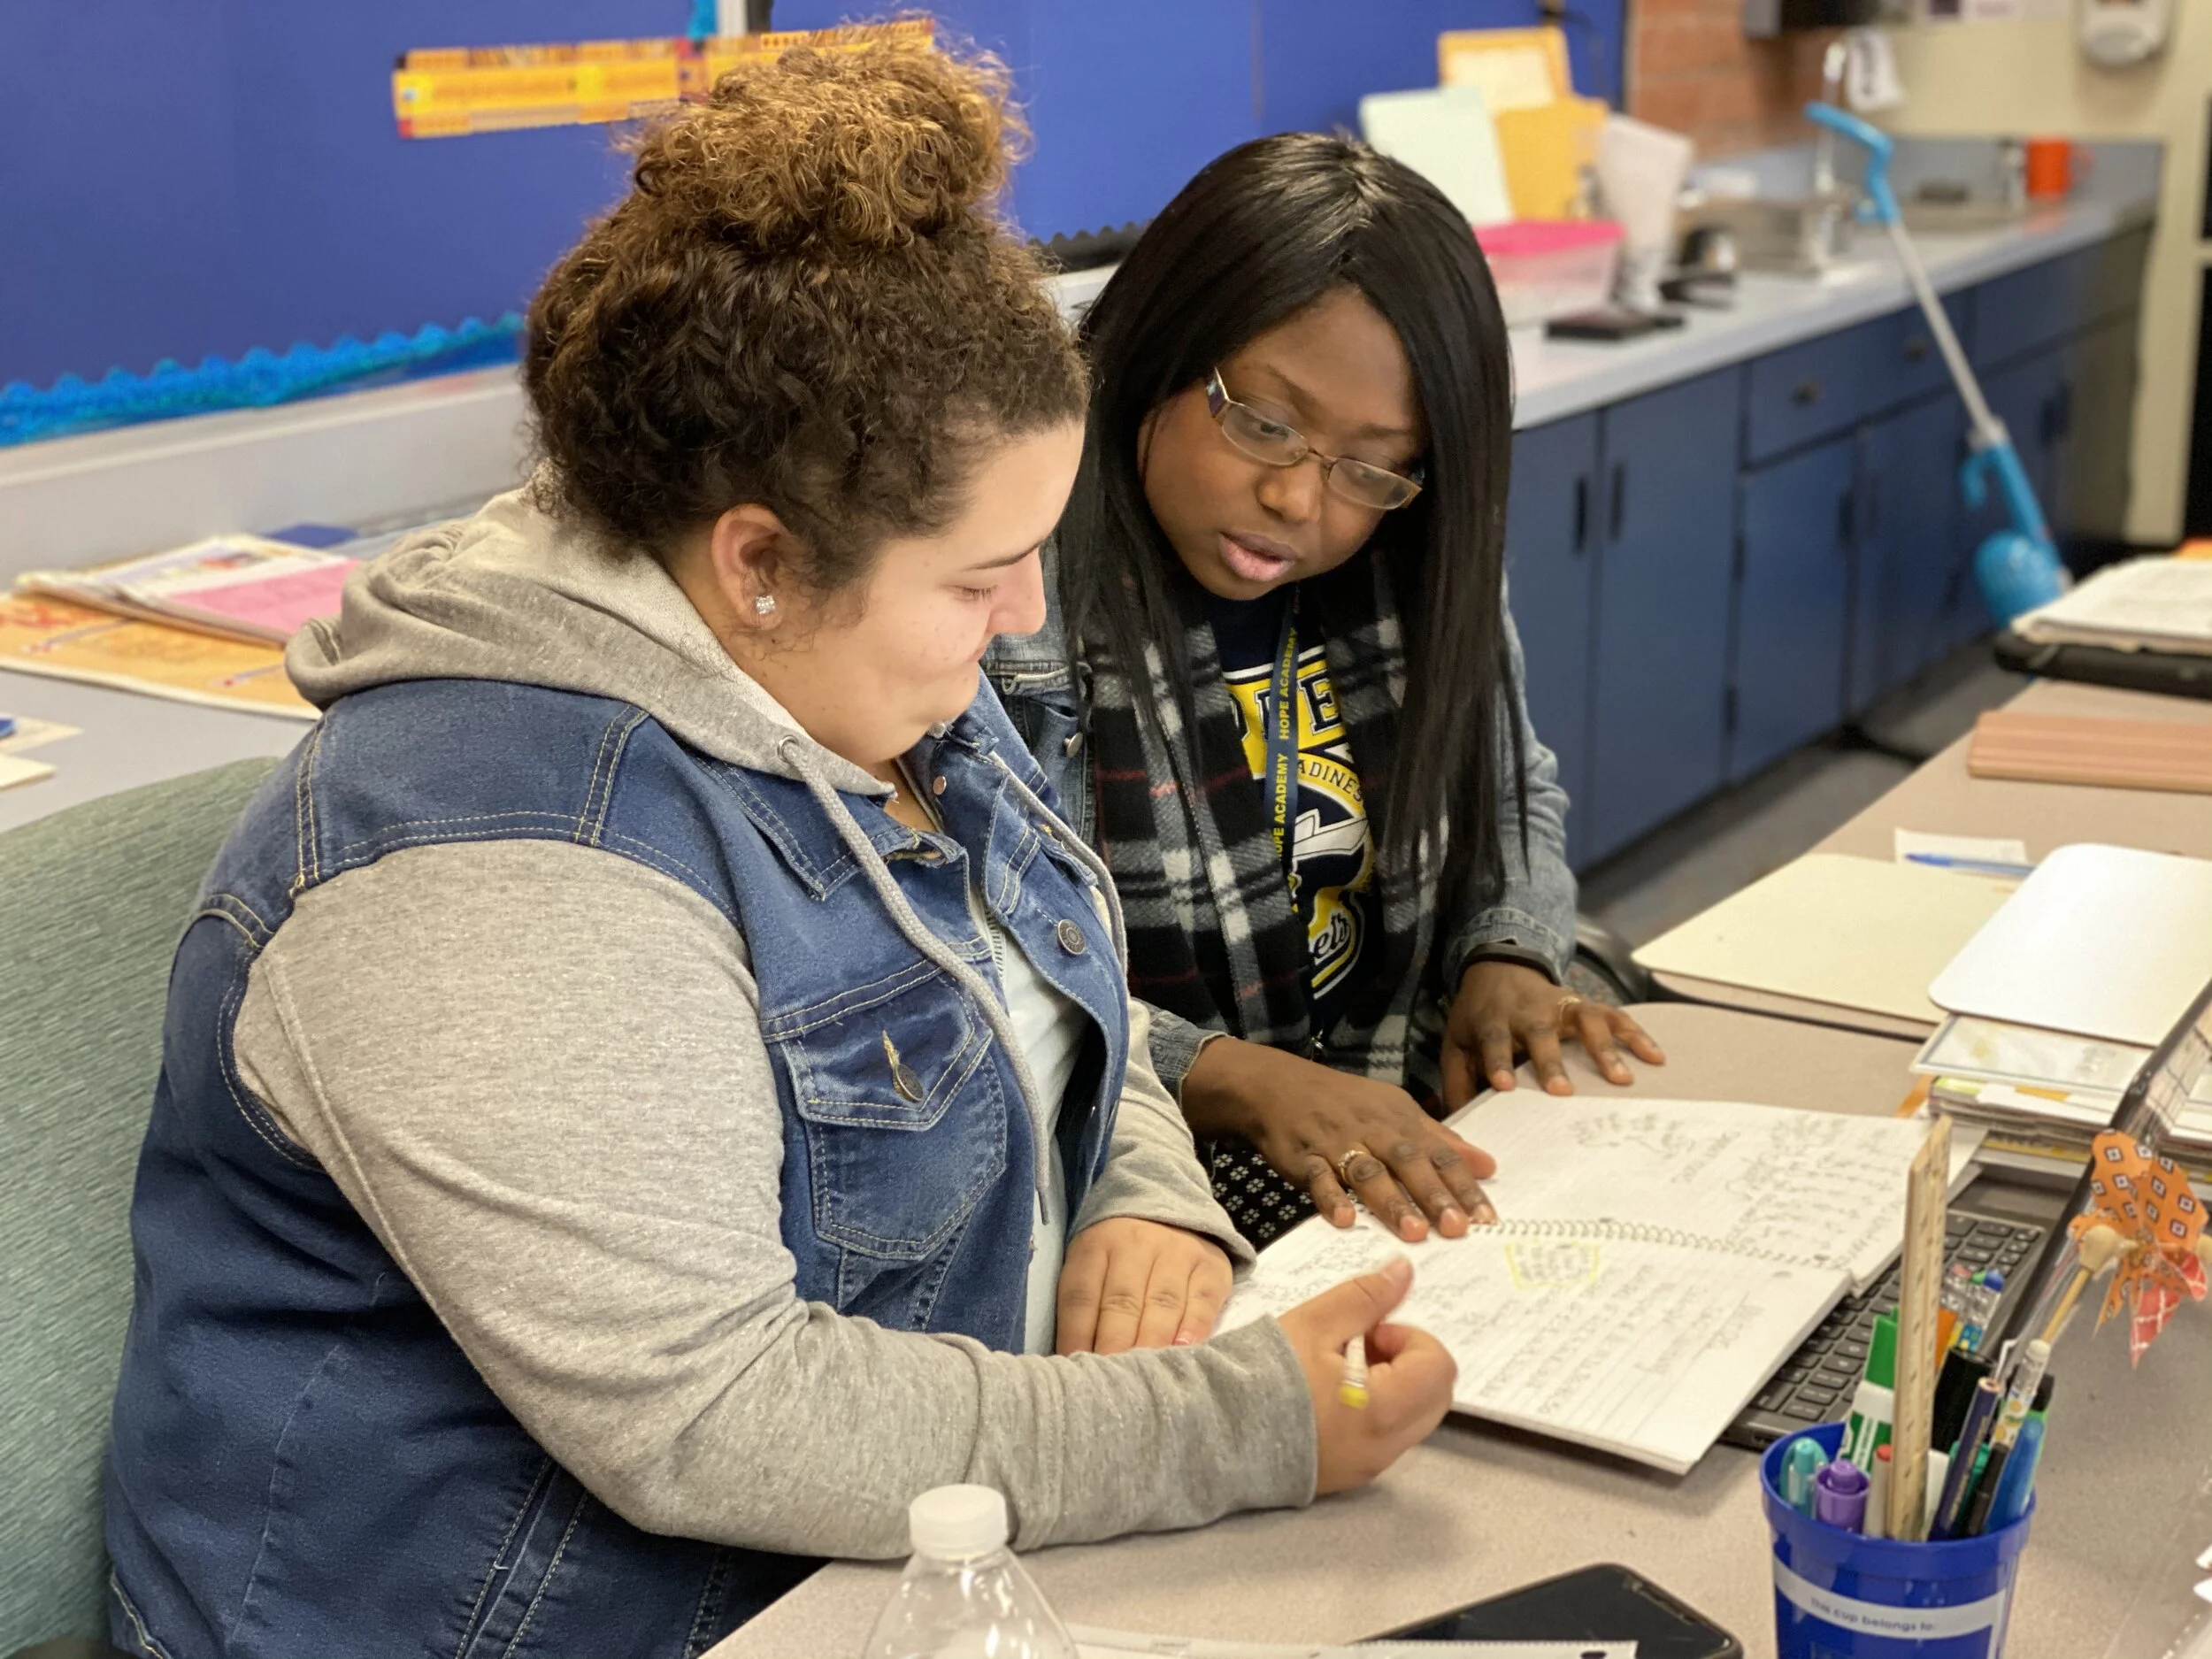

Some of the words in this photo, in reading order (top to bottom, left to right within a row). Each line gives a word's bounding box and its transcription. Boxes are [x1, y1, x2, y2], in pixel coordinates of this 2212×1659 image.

[1279, 626, 1298, 697] ACADEMY
[1279, 700, 1290, 740] HOPE
[1274, 753, 1289, 825] ACADEMY
[1273, 827, 1285, 862] OPE
